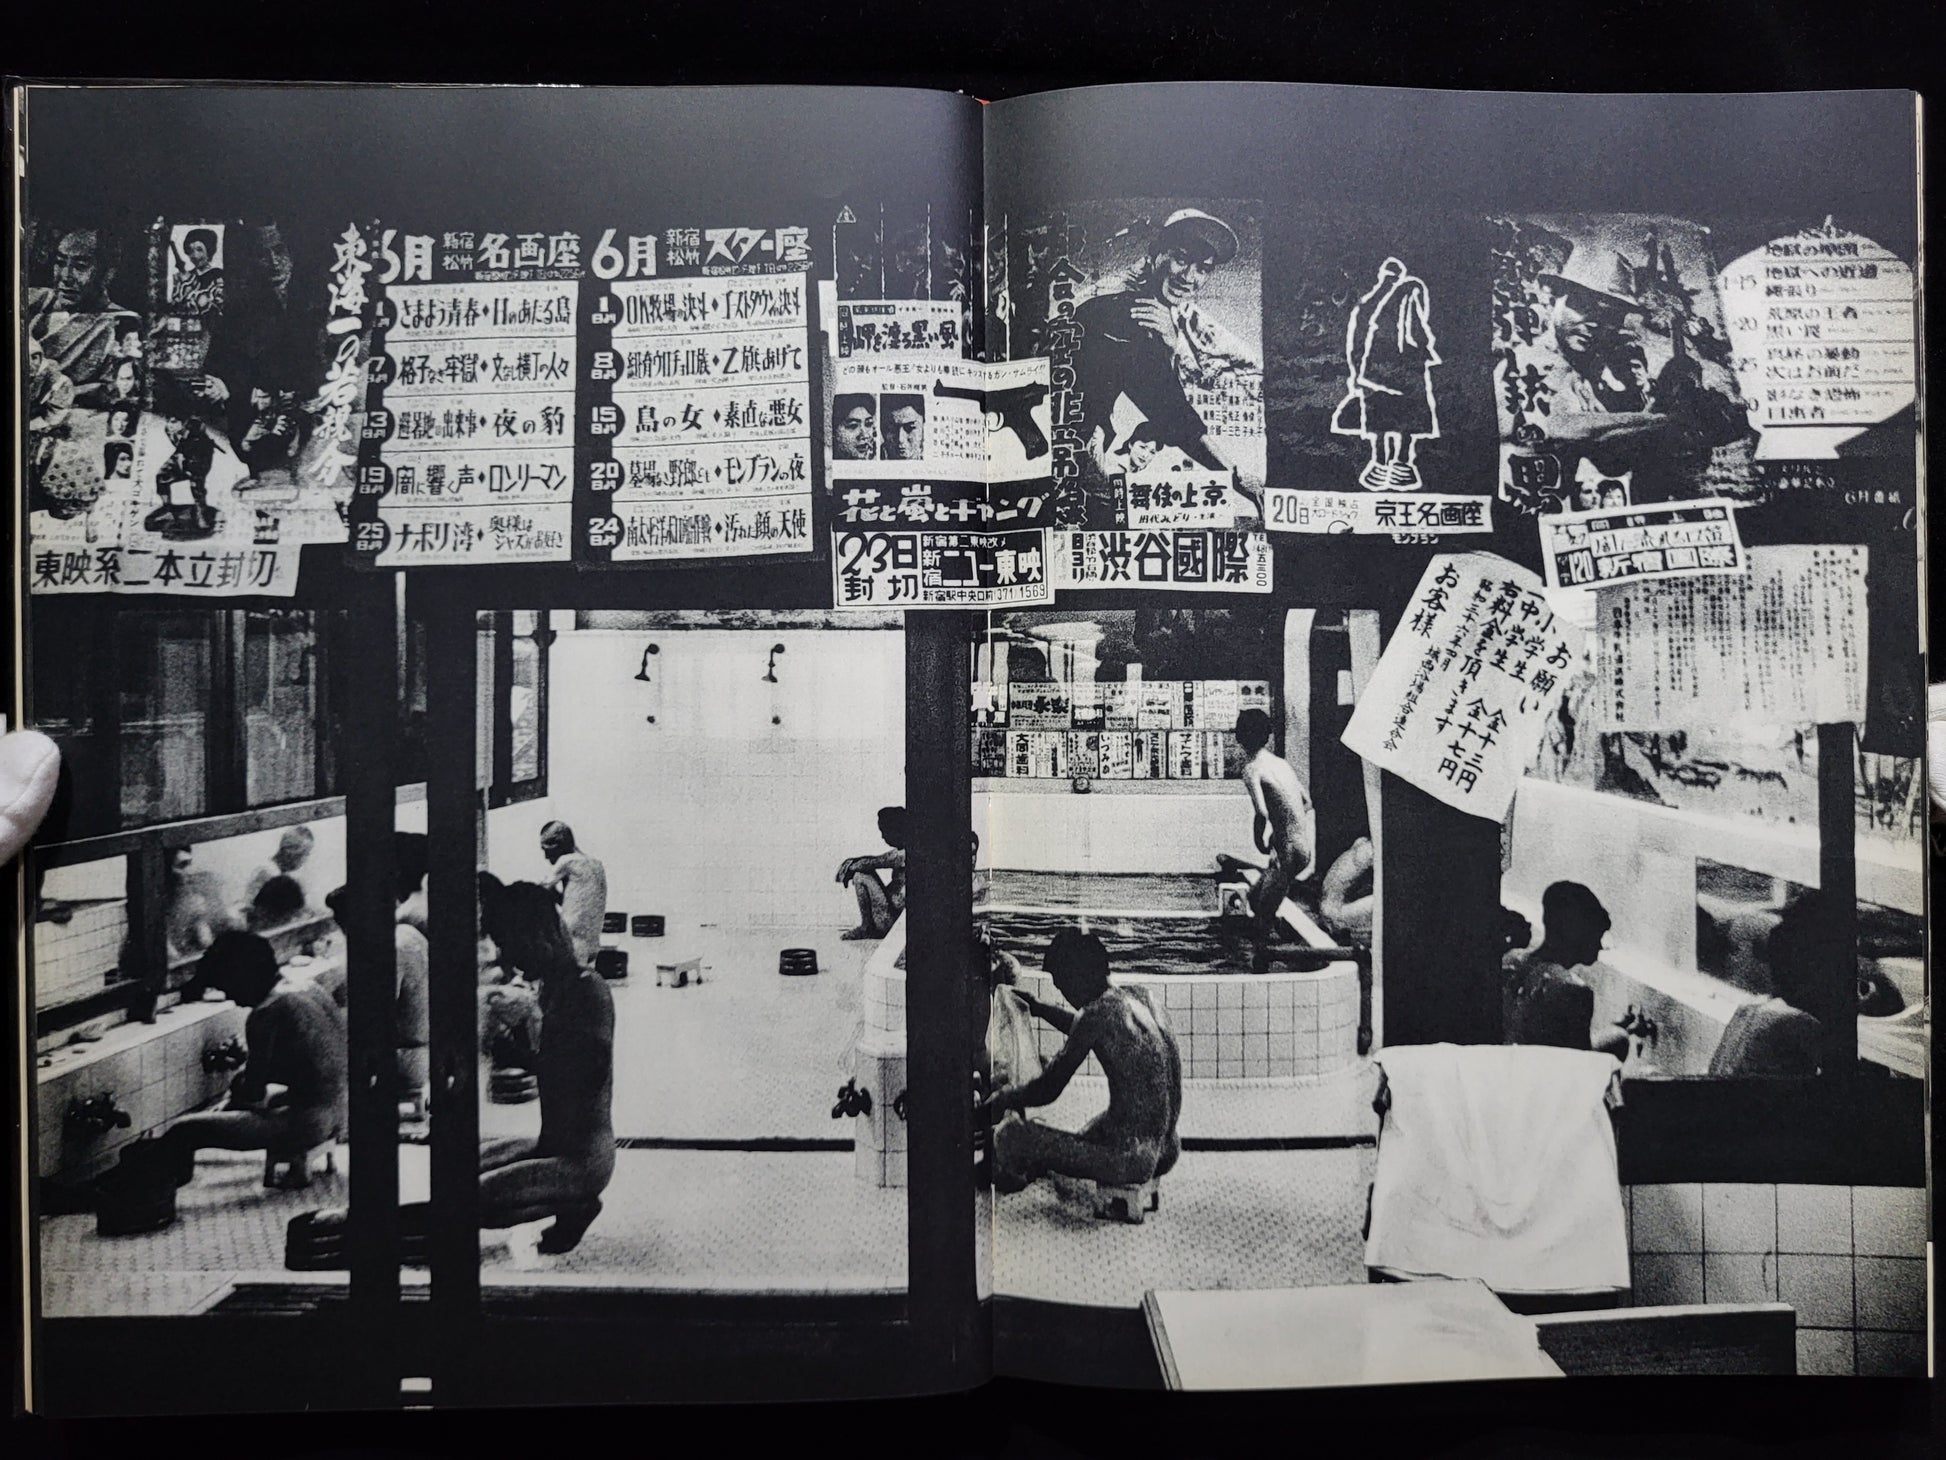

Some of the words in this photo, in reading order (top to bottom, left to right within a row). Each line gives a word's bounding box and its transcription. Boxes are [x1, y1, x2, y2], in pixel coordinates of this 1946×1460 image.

[477, 231, 581, 268] 名画座
[591, 228, 658, 280] 6月
[704, 226, 812, 264] スター座
[494, 406, 566, 437] 夜の豹
[591, 406, 617, 422] 15
[636, 403, 704, 432] 島の女
[724, 398, 804, 428] 素直な悪女
[360, 467, 386, 483] 19
[395, 464, 475, 496] 闇に響く声
[489, 464, 567, 492] ロンリーマン
[590, 463, 619, 478] 20
[838, 484, 1050, 523] 花と嵐とギャング
[1375, 500, 1484, 527] 京王名画座
[358, 523, 384, 539] 25
[395, 522, 474, 552] ナポリ湾
[588, 518, 620, 533] 24
[724, 509, 807, 543] 汚れた顔の天使
[34, 550, 277, 589] 東映系二本立封切
[838, 532, 919, 575] 23日
[942, 547, 1042, 588] ニュー東映
[1100, 532, 1250, 583] 渋谷國際
[1568, 551, 1595, 583] 120
[844, 575, 919, 601] 封切
[1409, 562, 1460, 639] お客様
[1520, 641, 1572, 714] お願い
